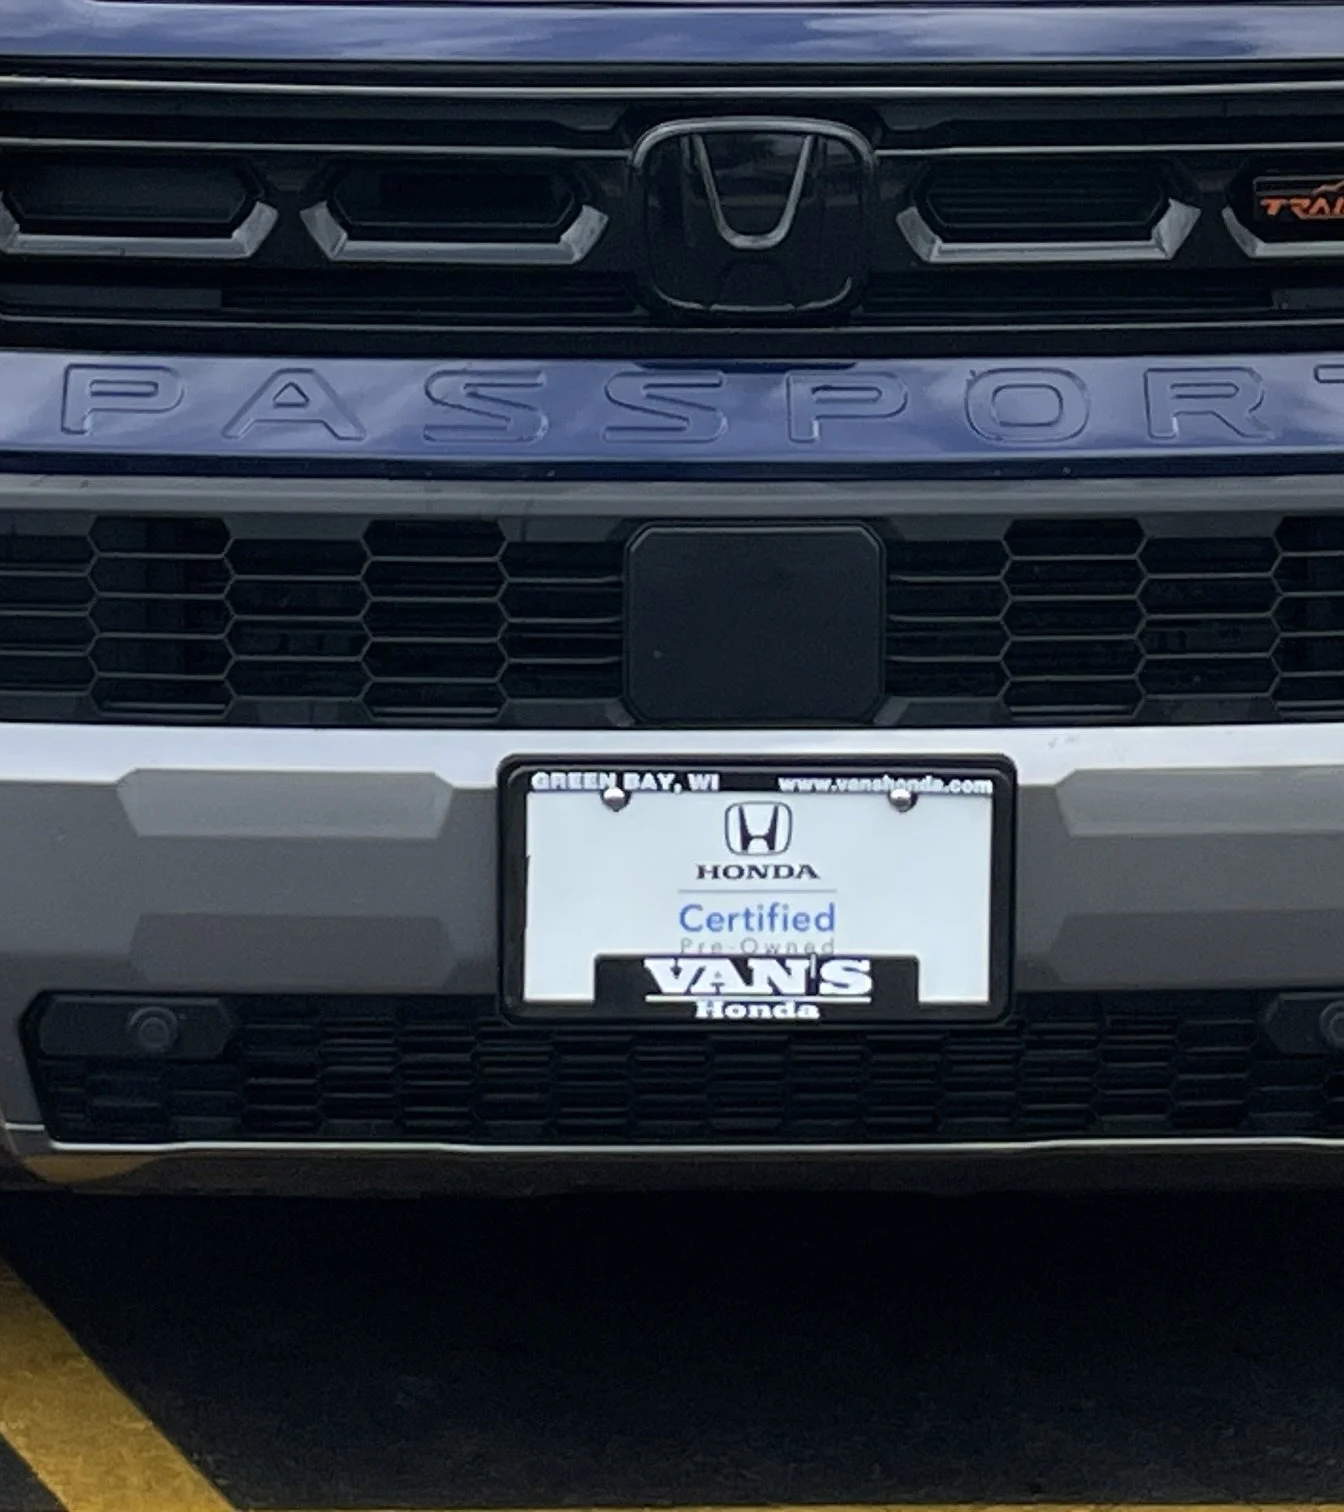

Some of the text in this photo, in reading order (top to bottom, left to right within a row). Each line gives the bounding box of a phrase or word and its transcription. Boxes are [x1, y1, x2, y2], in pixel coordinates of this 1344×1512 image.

[531, 772, 720, 794] GREEN BAY, WI
[777, 774, 994, 794] www.vanshonda.com
[695, 863, 821, 881] HONDA
[679, 902, 836, 933] Certified
[679, 937, 836, 956] Pre-Owned
[644, 953, 873, 995] VAN'S
[695, 999, 821, 1020] Honda
